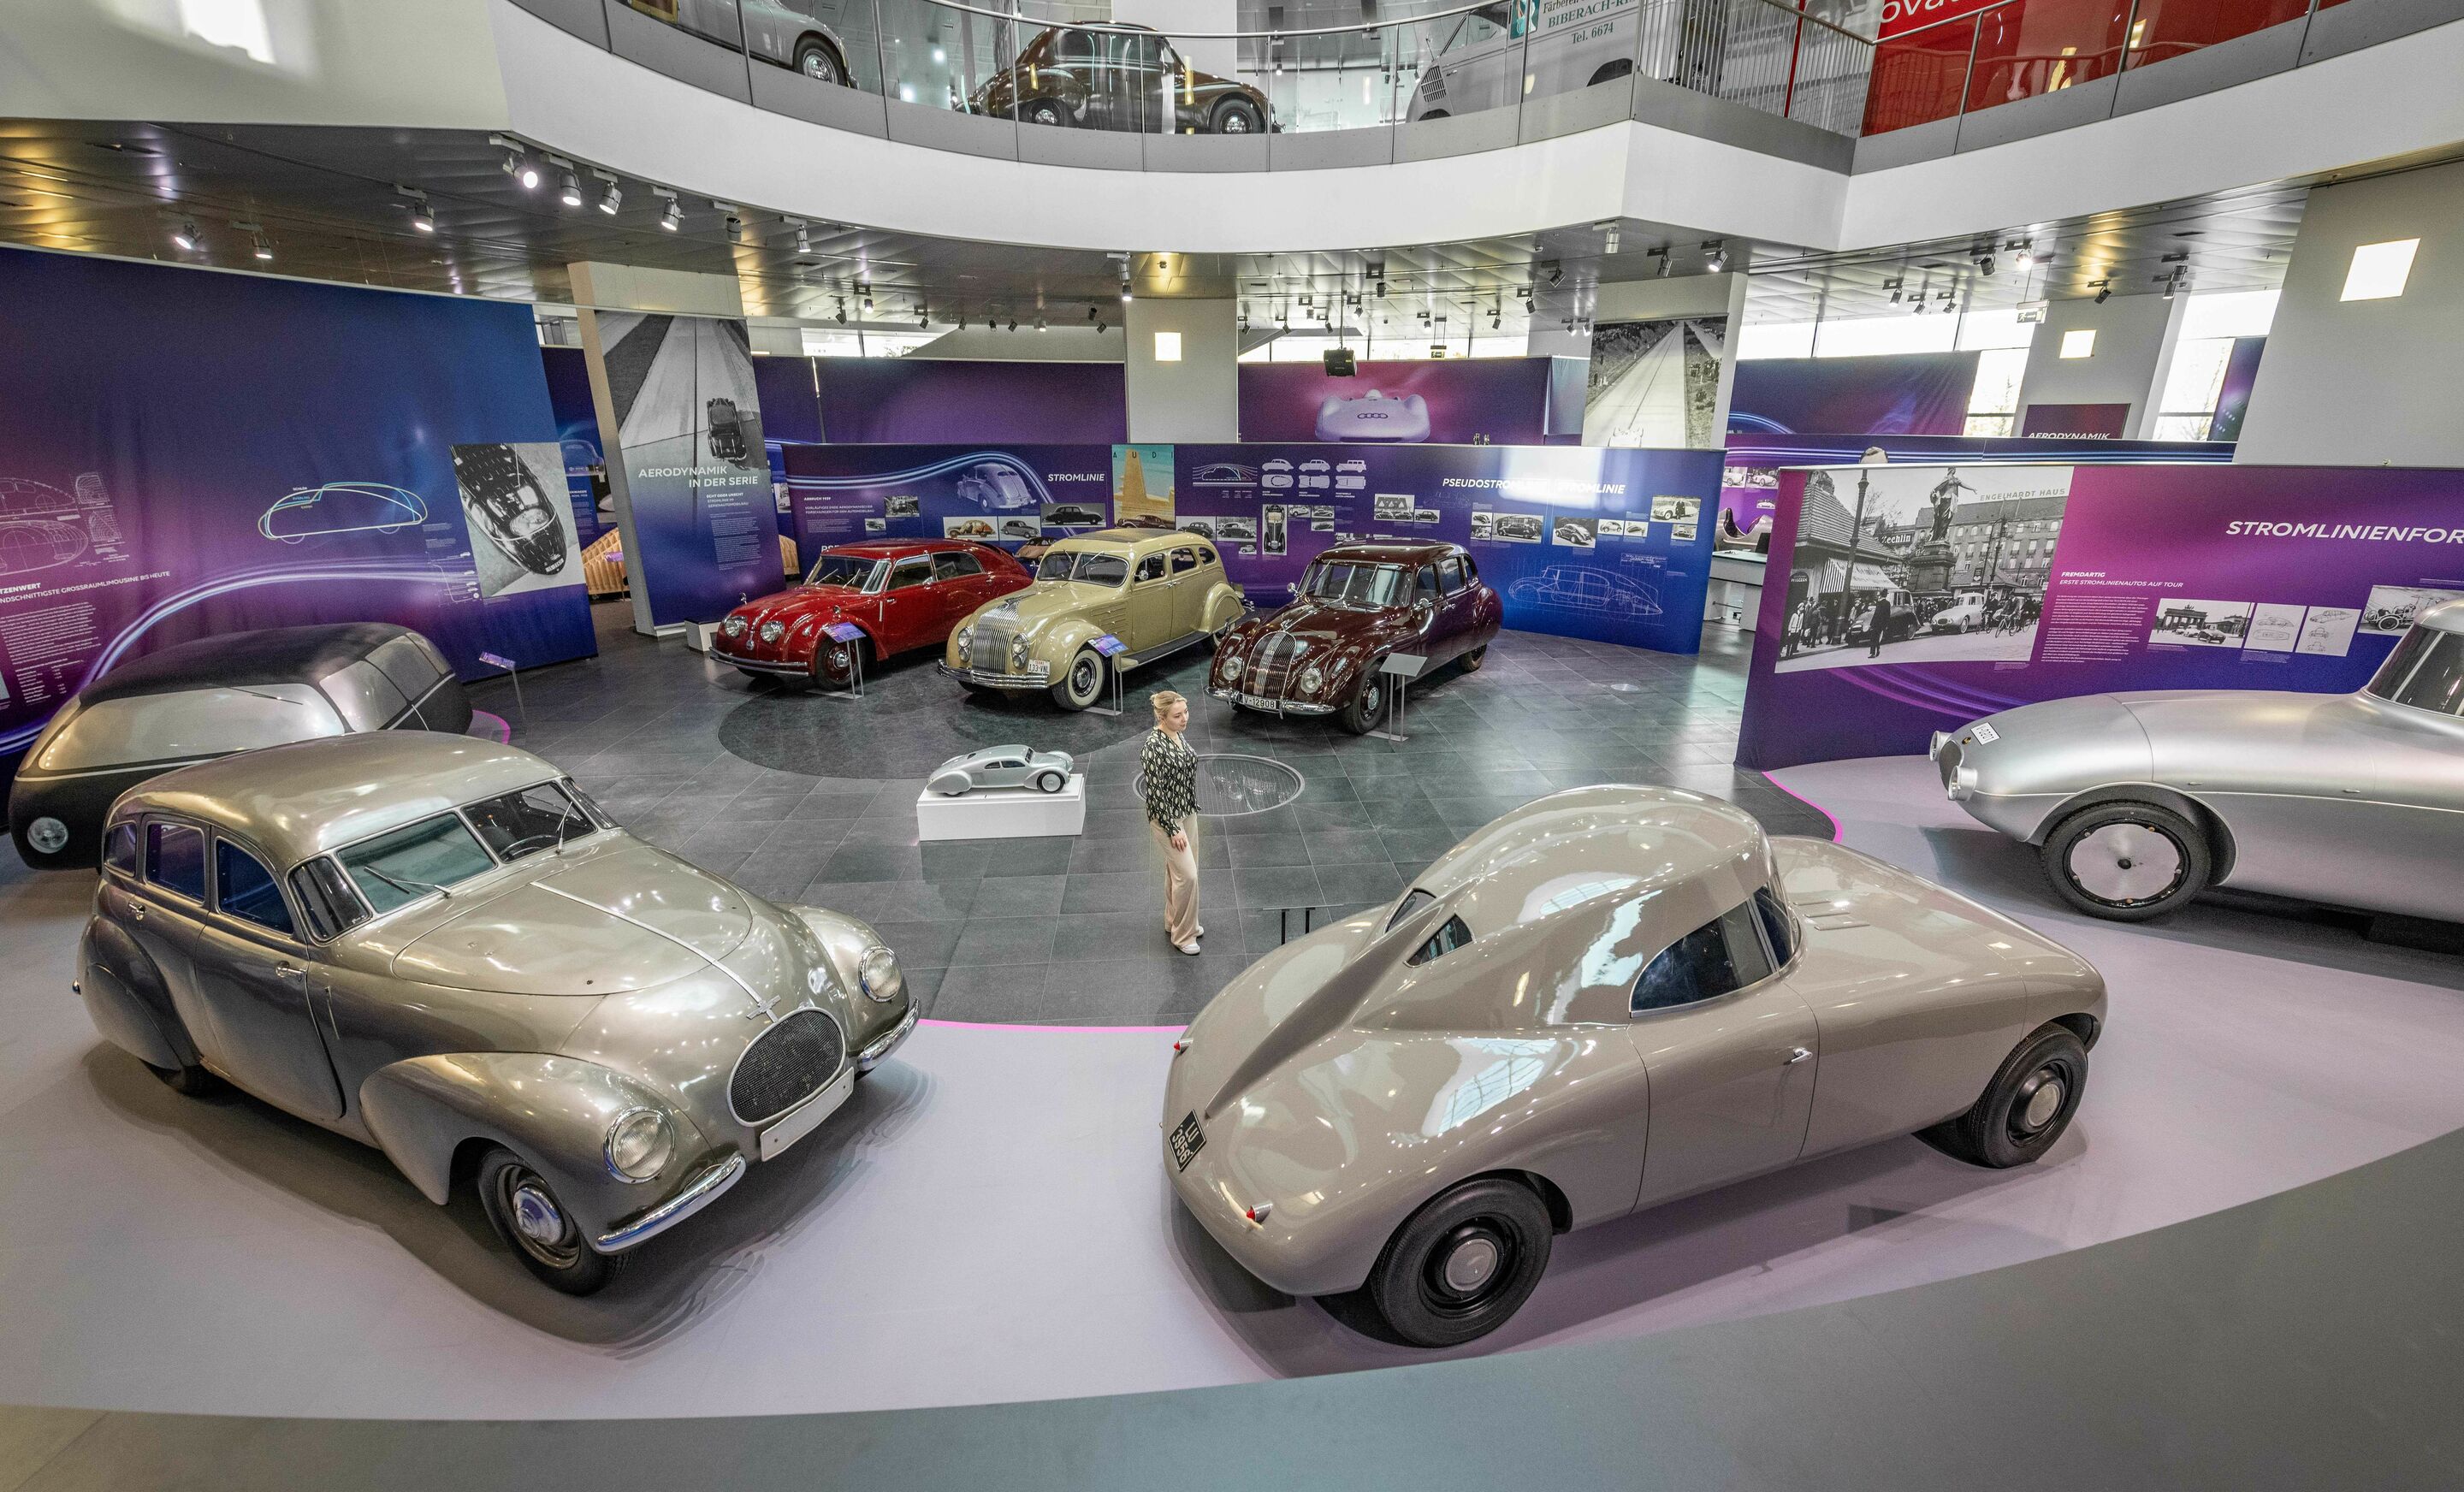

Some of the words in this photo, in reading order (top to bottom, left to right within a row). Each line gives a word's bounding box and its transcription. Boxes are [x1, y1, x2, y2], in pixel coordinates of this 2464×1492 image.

[1571, 30, 1588, 44] Tel.
[1591, 21, 1614, 38] 6674
[638, 466, 727, 478] AERODYNAMIK
[1047, 473, 1105, 482] STROMLINIE
[689, 478, 701, 488] IN
[704, 478, 726, 487] DER
[729, 477, 758, 485] SERIE
[1980, 490, 2036, 501] ENGELHARDT
[2226, 521, 2464, 544] STROMLINIENFOR
[61, 576, 139, 593] GROSSRAUMLIMOUSINE
[1244, 696, 1275, 708] V-12908
[1185, 1121, 1199, 1143] LU
[1172, 1128, 1190, 1163] 3956
